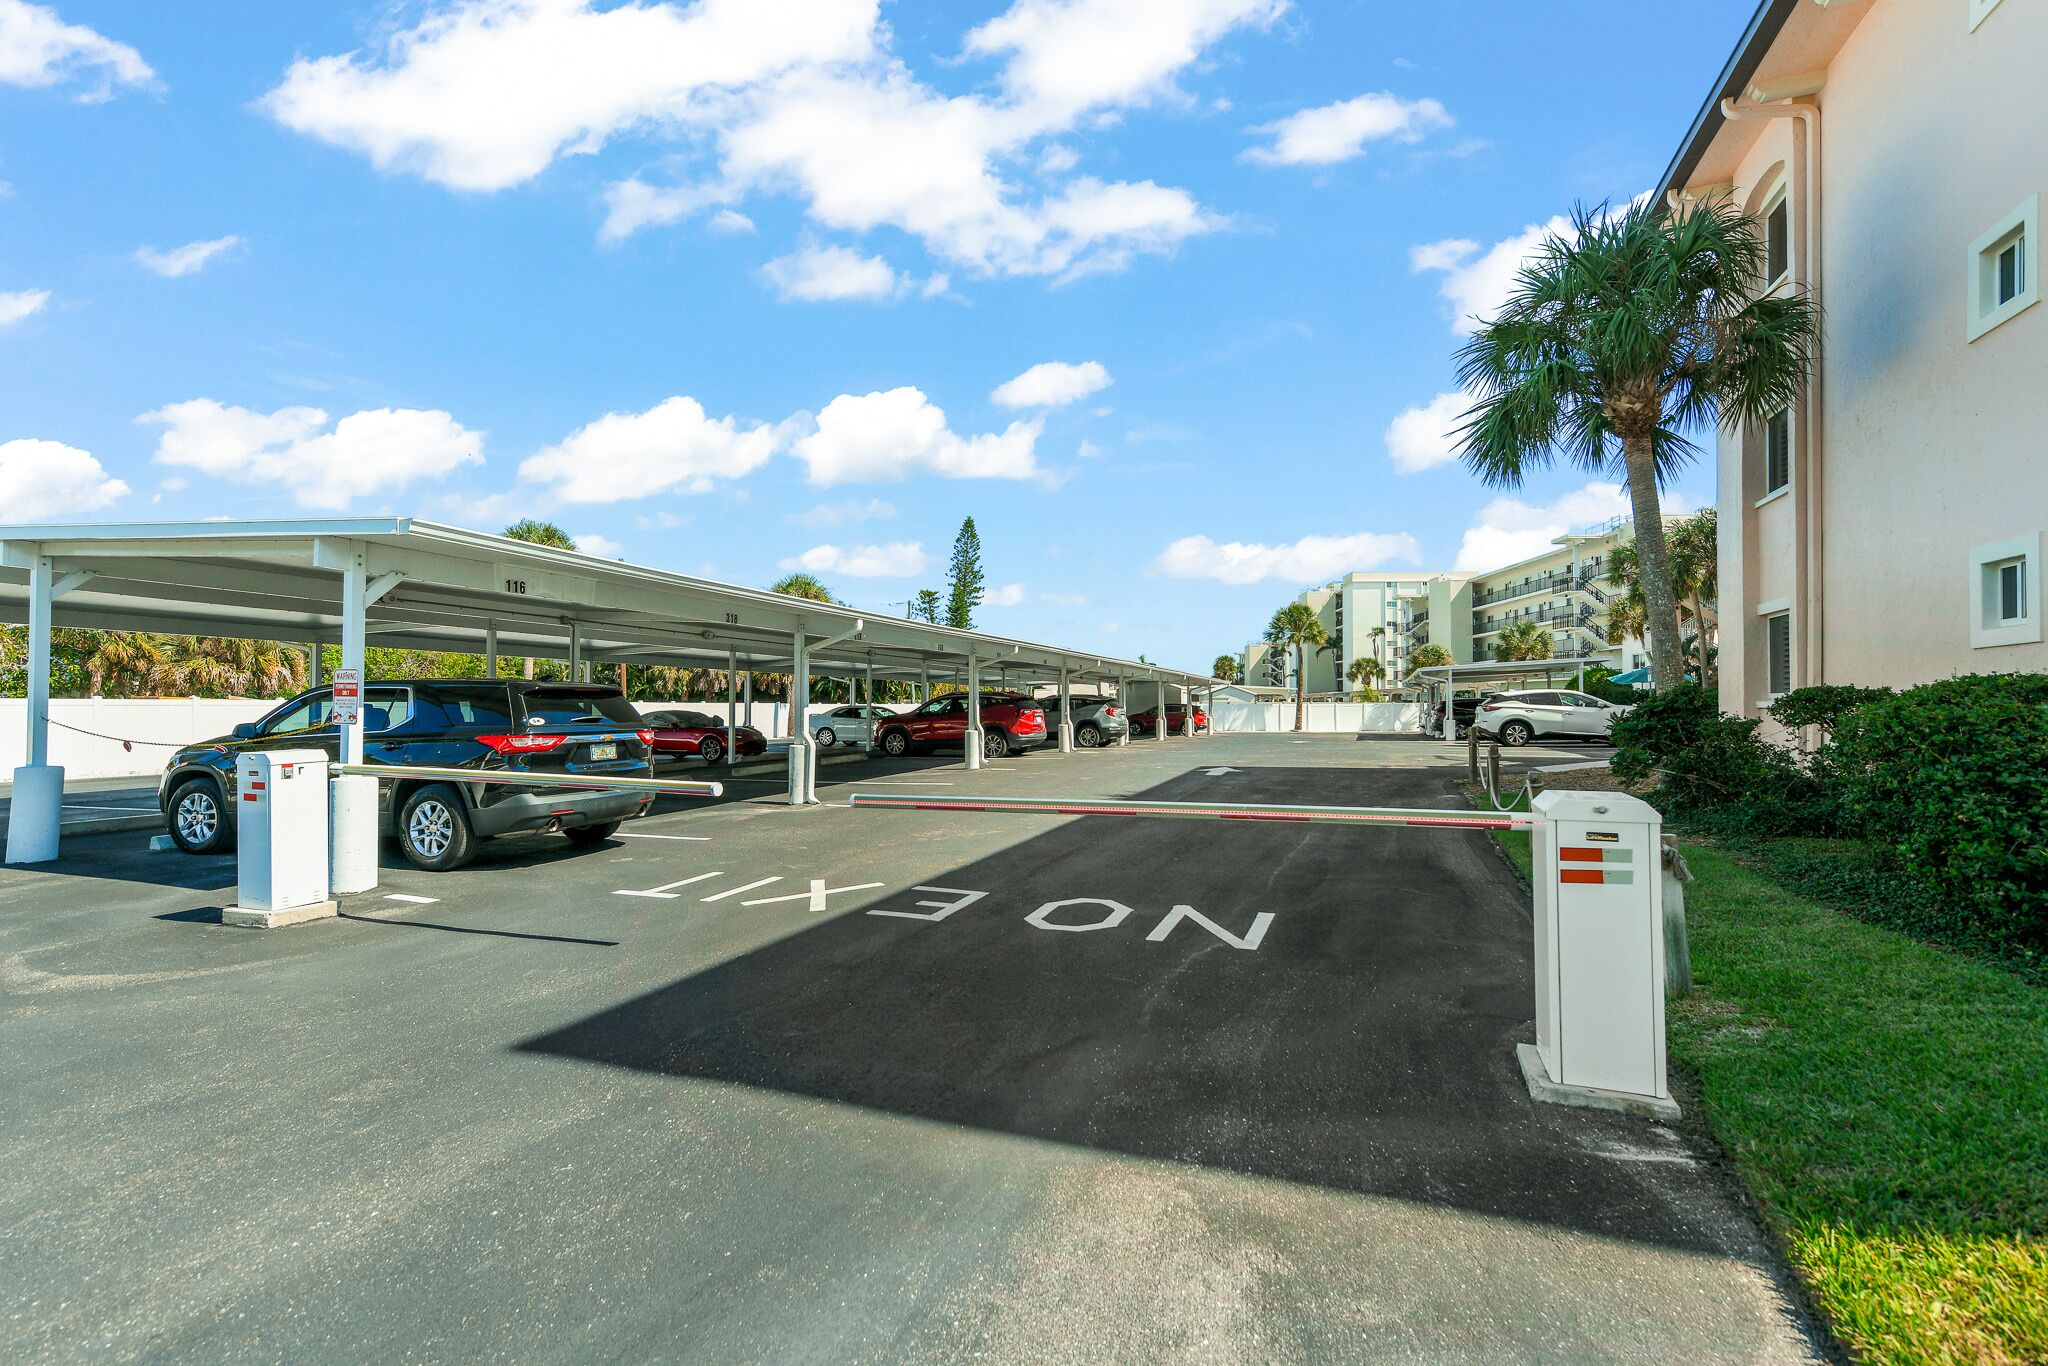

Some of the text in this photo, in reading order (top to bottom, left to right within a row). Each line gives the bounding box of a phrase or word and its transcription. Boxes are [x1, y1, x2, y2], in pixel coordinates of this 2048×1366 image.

[506, 579, 525, 594] 116
[336, 672, 357, 681] WARNING
[610, 871, 1277, 950] NO EXIT
